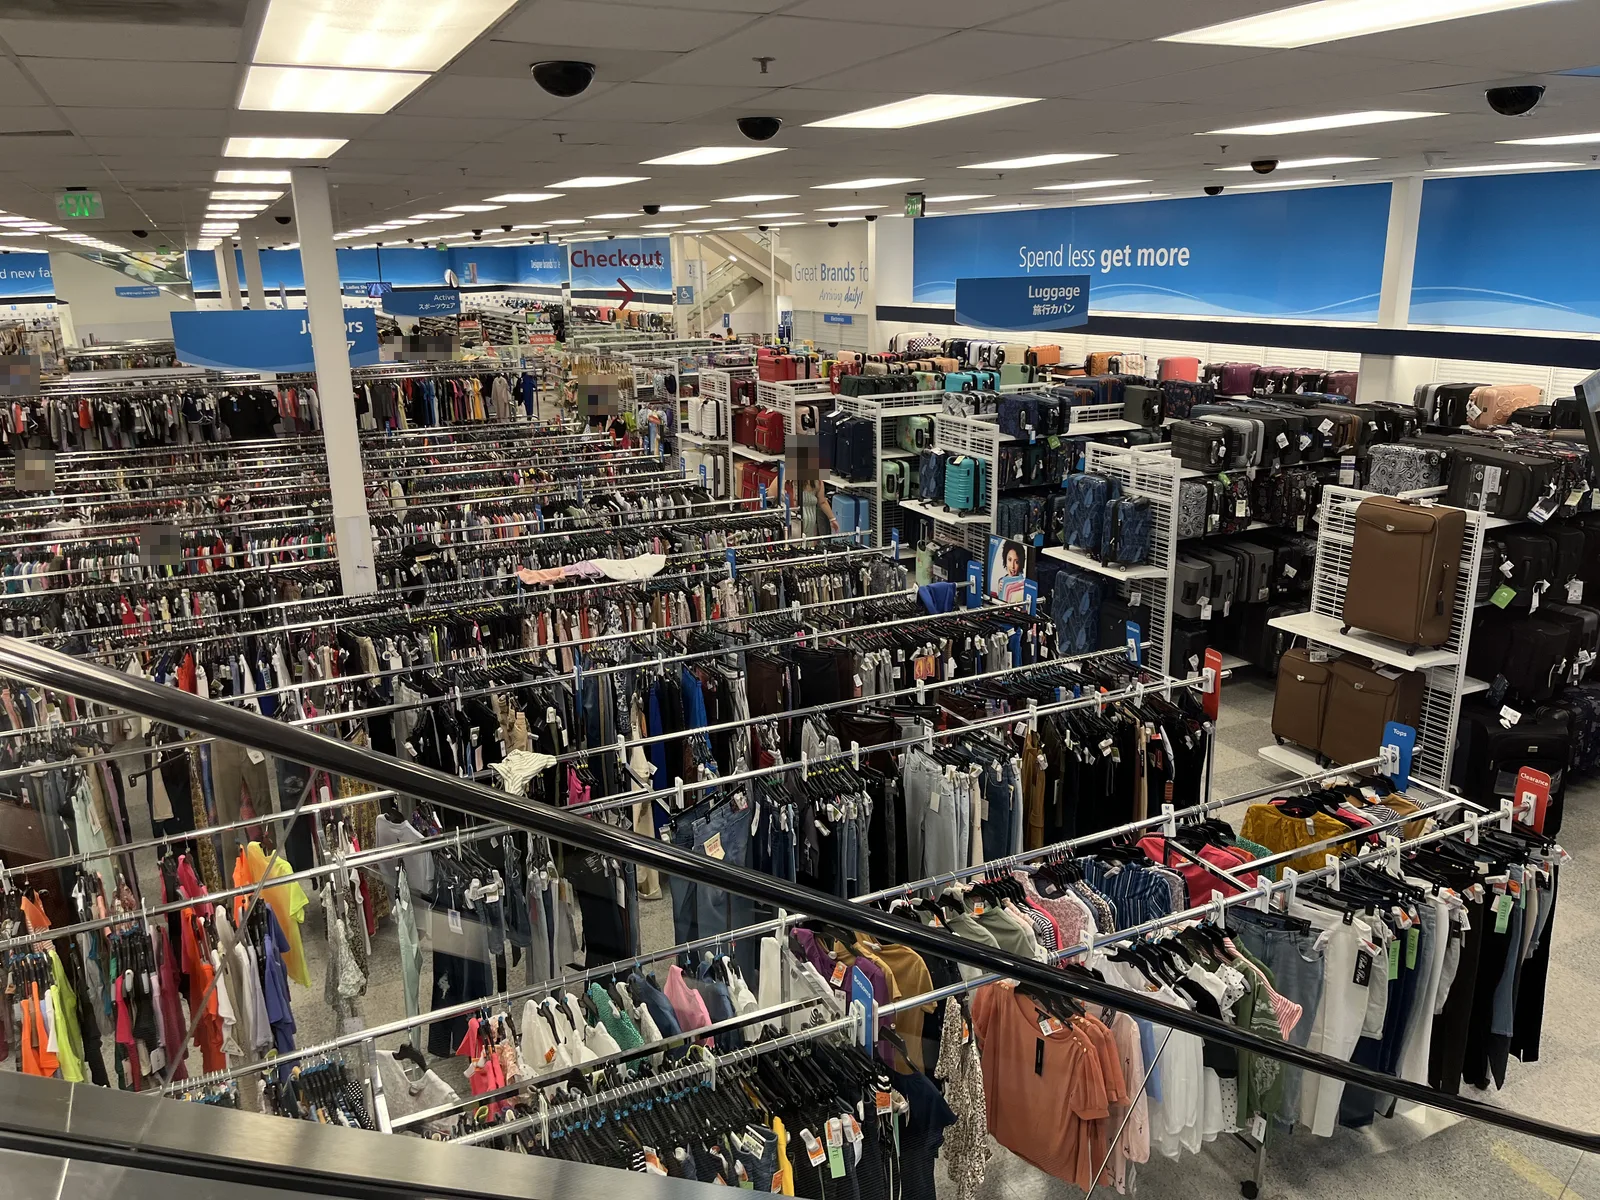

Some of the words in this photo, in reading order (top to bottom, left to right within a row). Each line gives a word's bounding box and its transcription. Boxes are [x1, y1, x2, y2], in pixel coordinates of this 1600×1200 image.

[64, 194, 96, 217] EXIT
[570, 249, 662, 268] Checkout
[1019, 245, 1063, 273] Spend
[1068, 243, 1096, 268] less
[1101, 244, 1132, 274] get
[1137, 246, 1191, 267] more
[10, 270, 36, 279] new
[794, 263, 817, 281] Great
[821, 261, 856, 282] Brands
[844, 286, 864, 309] daily!
[1028, 285, 1081, 301] Luggage
[1032, 303, 1075, 316] 旅行カバン
[1393, 728, 1407, 737] Tops
[1521, 773, 1549, 787] Clearance
